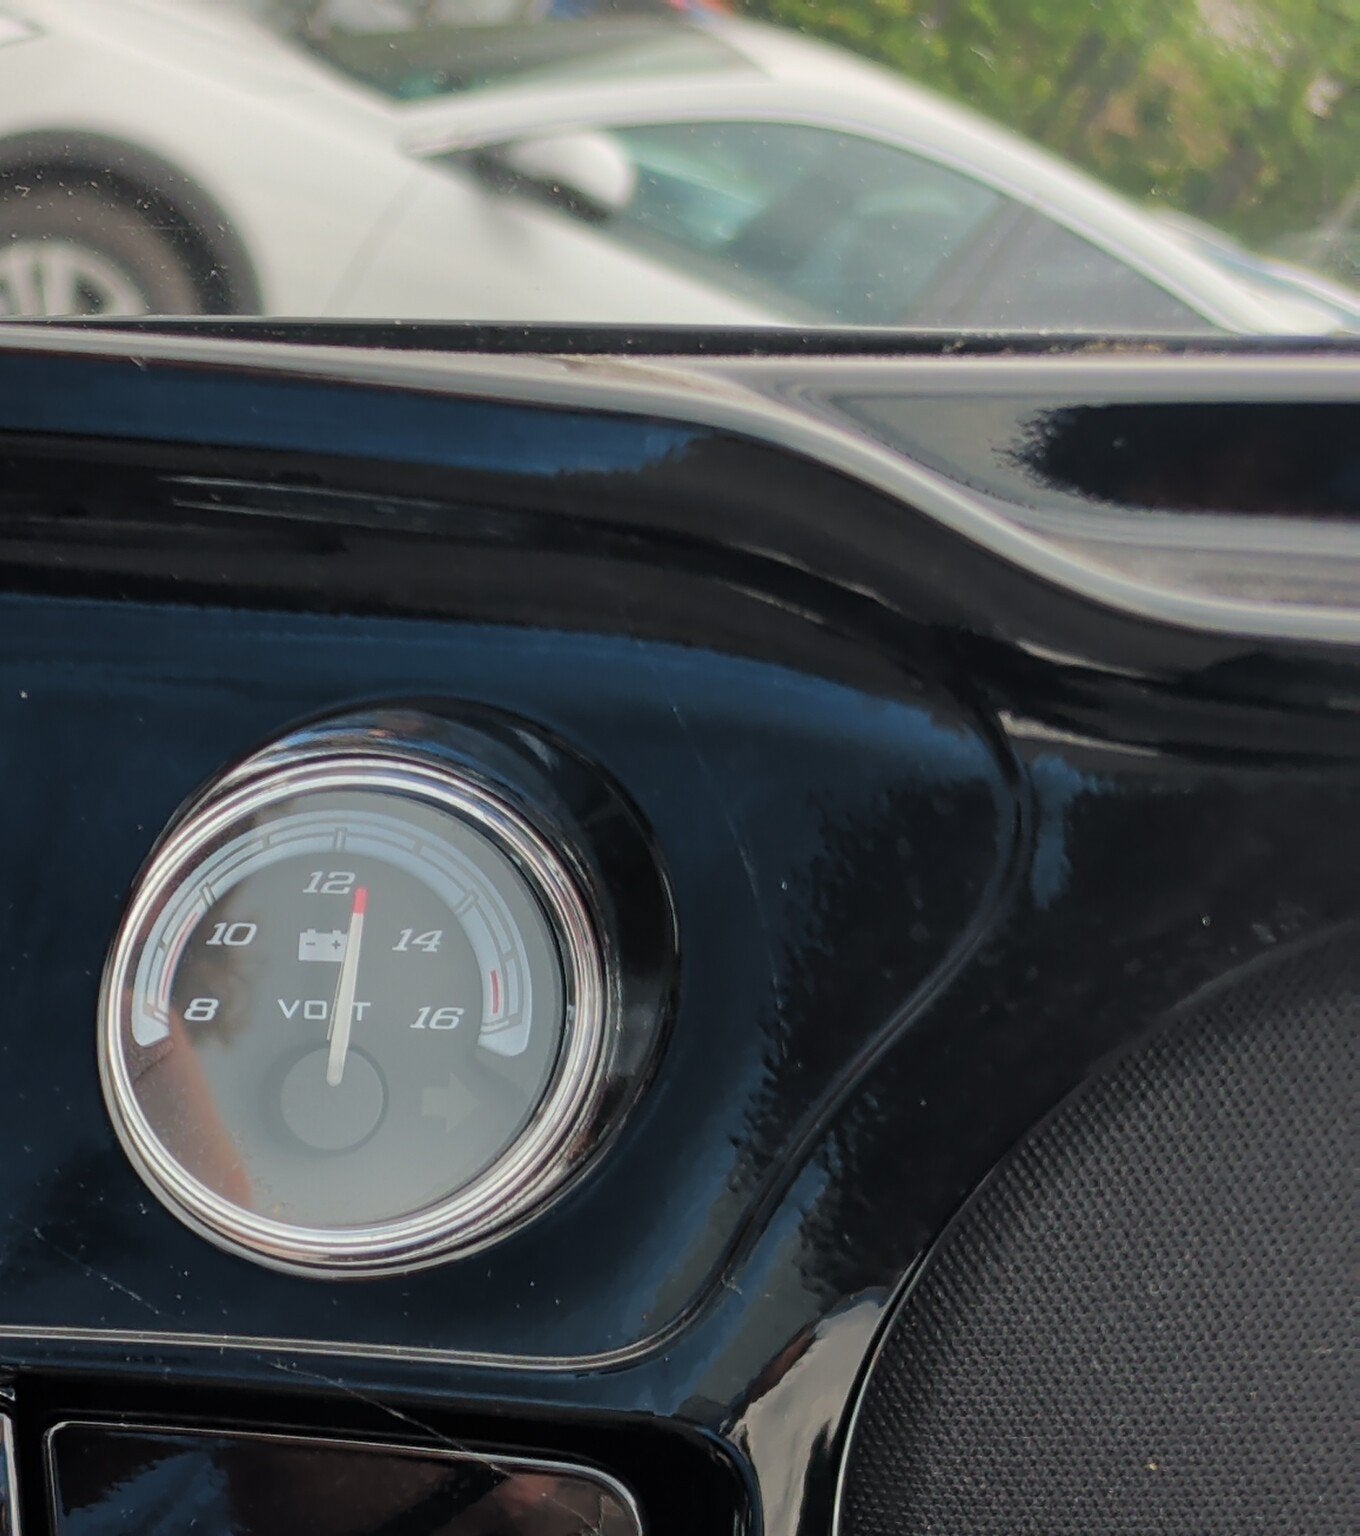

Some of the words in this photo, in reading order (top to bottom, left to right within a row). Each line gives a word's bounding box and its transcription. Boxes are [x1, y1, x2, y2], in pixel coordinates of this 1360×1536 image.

[302, 871, 356, 895] 12
[206, 921, 257, 946] 10
[392, 928, 444, 953] 14
[184, 998, 219, 1021] 8
[277, 998, 371, 1021] VOT
[409, 1006, 463, 1031] 16
